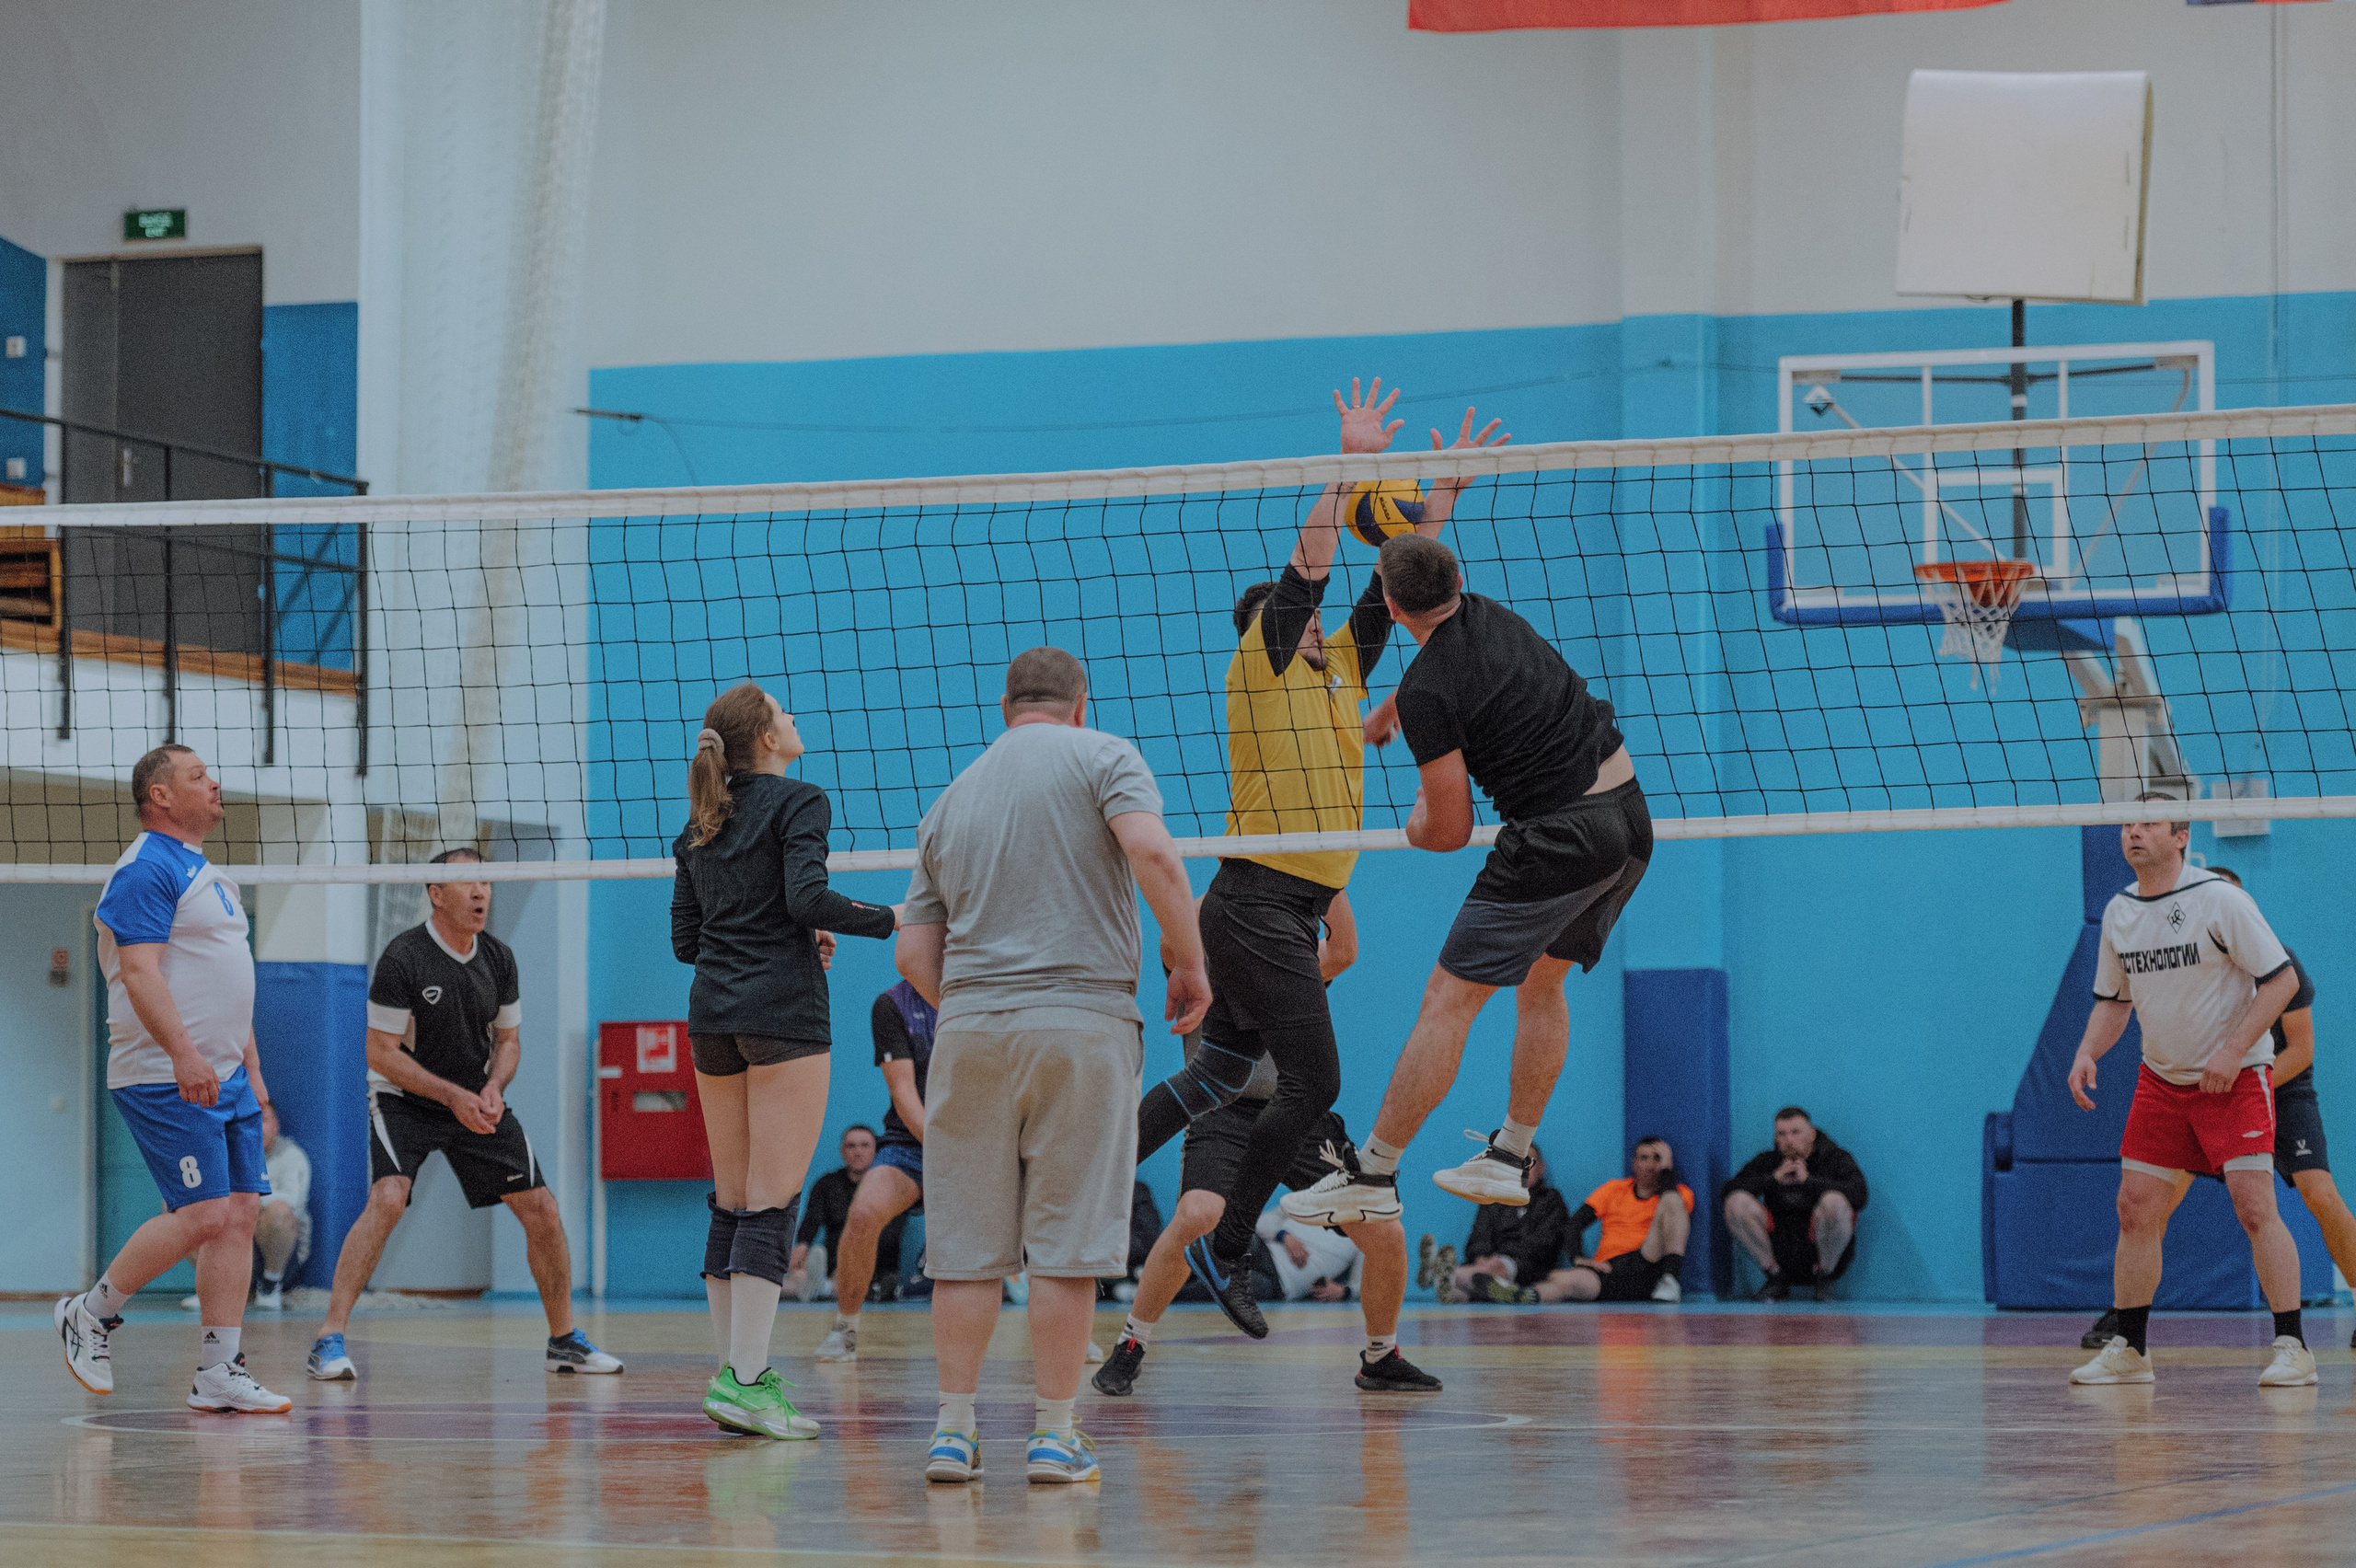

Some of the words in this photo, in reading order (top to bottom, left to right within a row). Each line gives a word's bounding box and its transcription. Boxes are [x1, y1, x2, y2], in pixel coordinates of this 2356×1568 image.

[214, 882, 234, 916] 8
[2118, 941, 2201, 974] ОСТЕХНОЛОГИИ
[179, 1156, 202, 1188] 8
